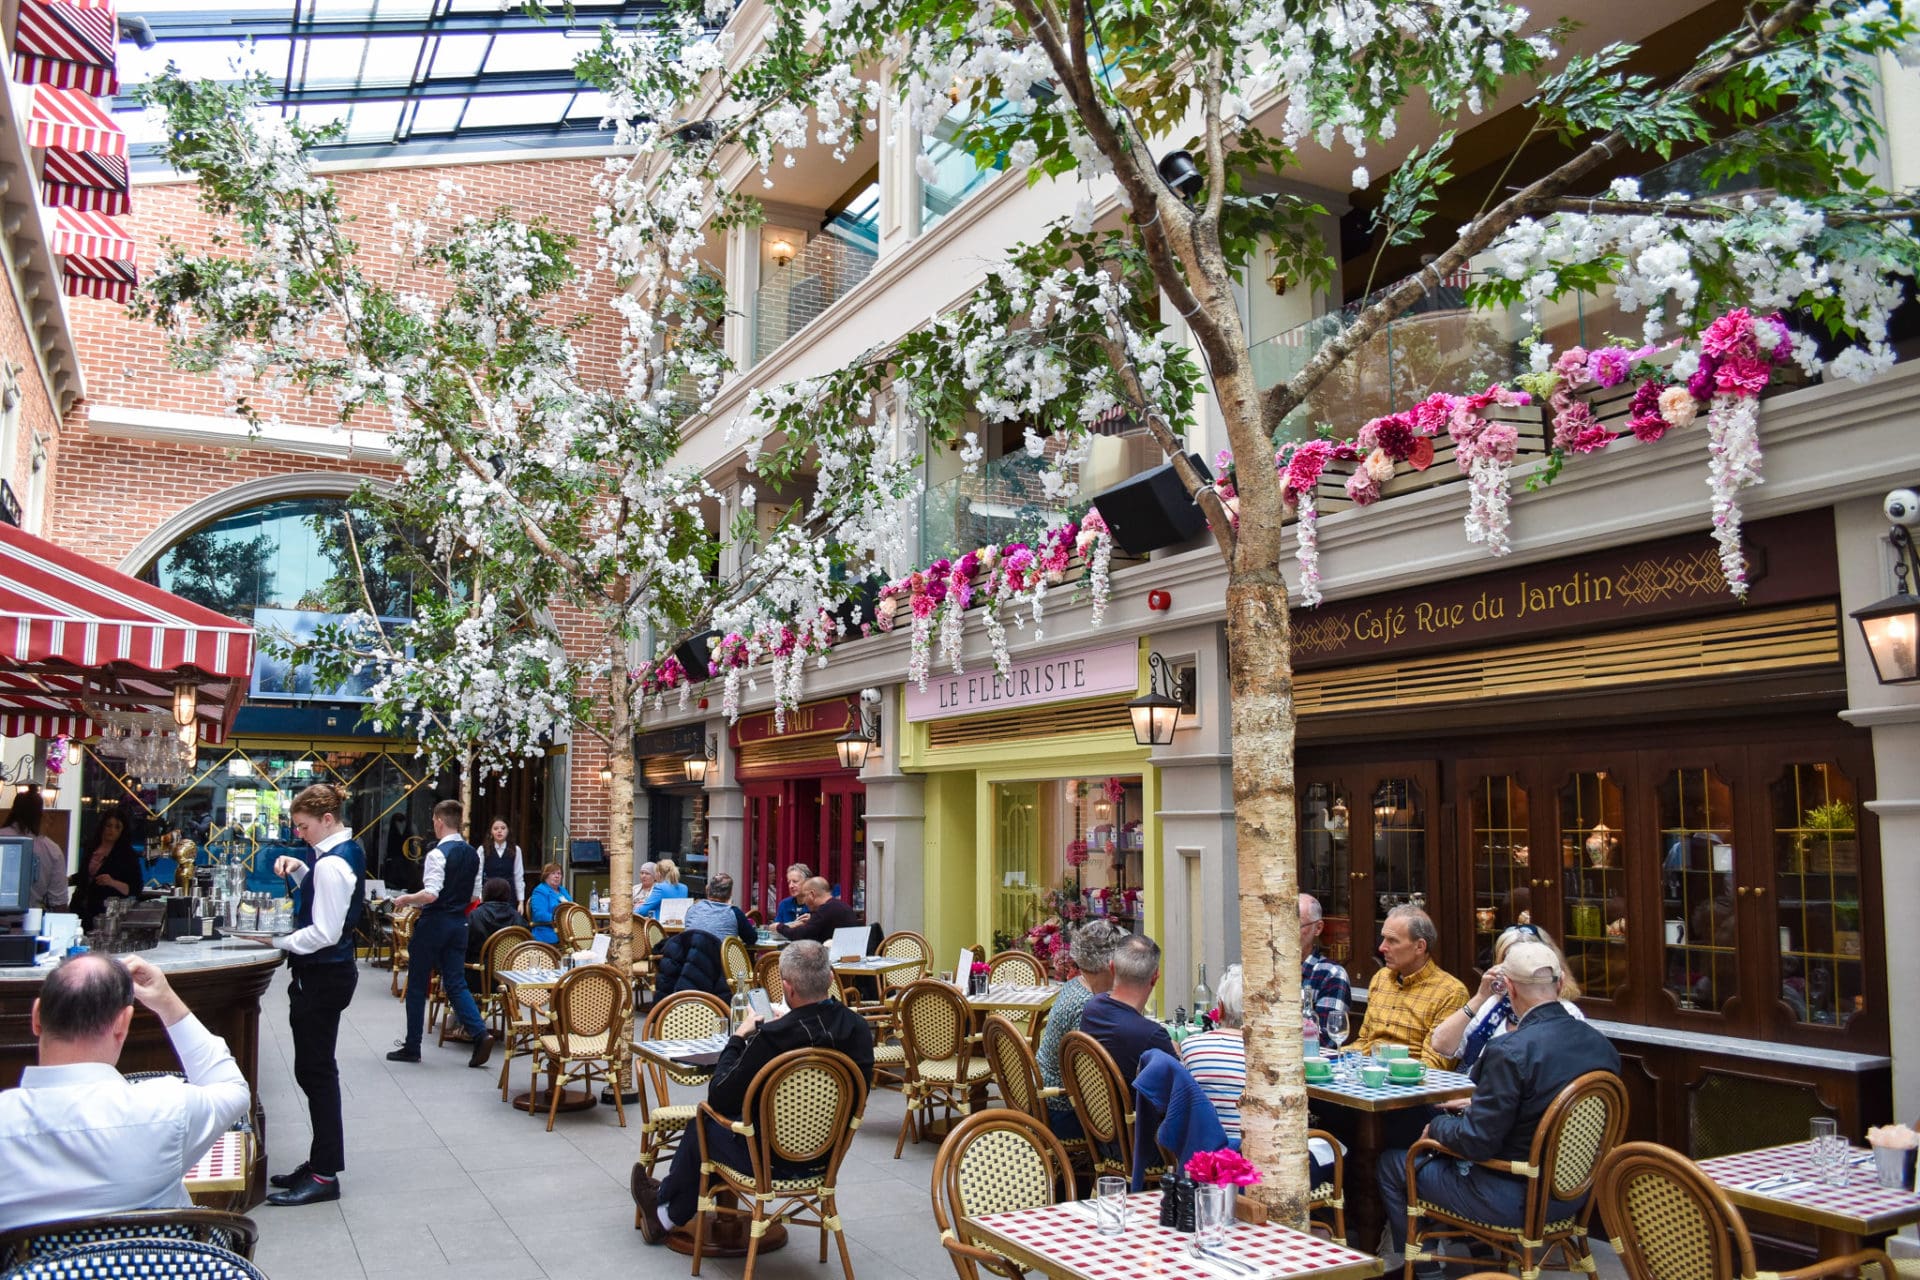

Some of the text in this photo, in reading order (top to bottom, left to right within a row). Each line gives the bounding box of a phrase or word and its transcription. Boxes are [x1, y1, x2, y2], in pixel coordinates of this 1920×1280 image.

[1354, 572, 1612, 644] Café Rue du Jardin
[939, 659, 1085, 708] LE FLEURISTE
